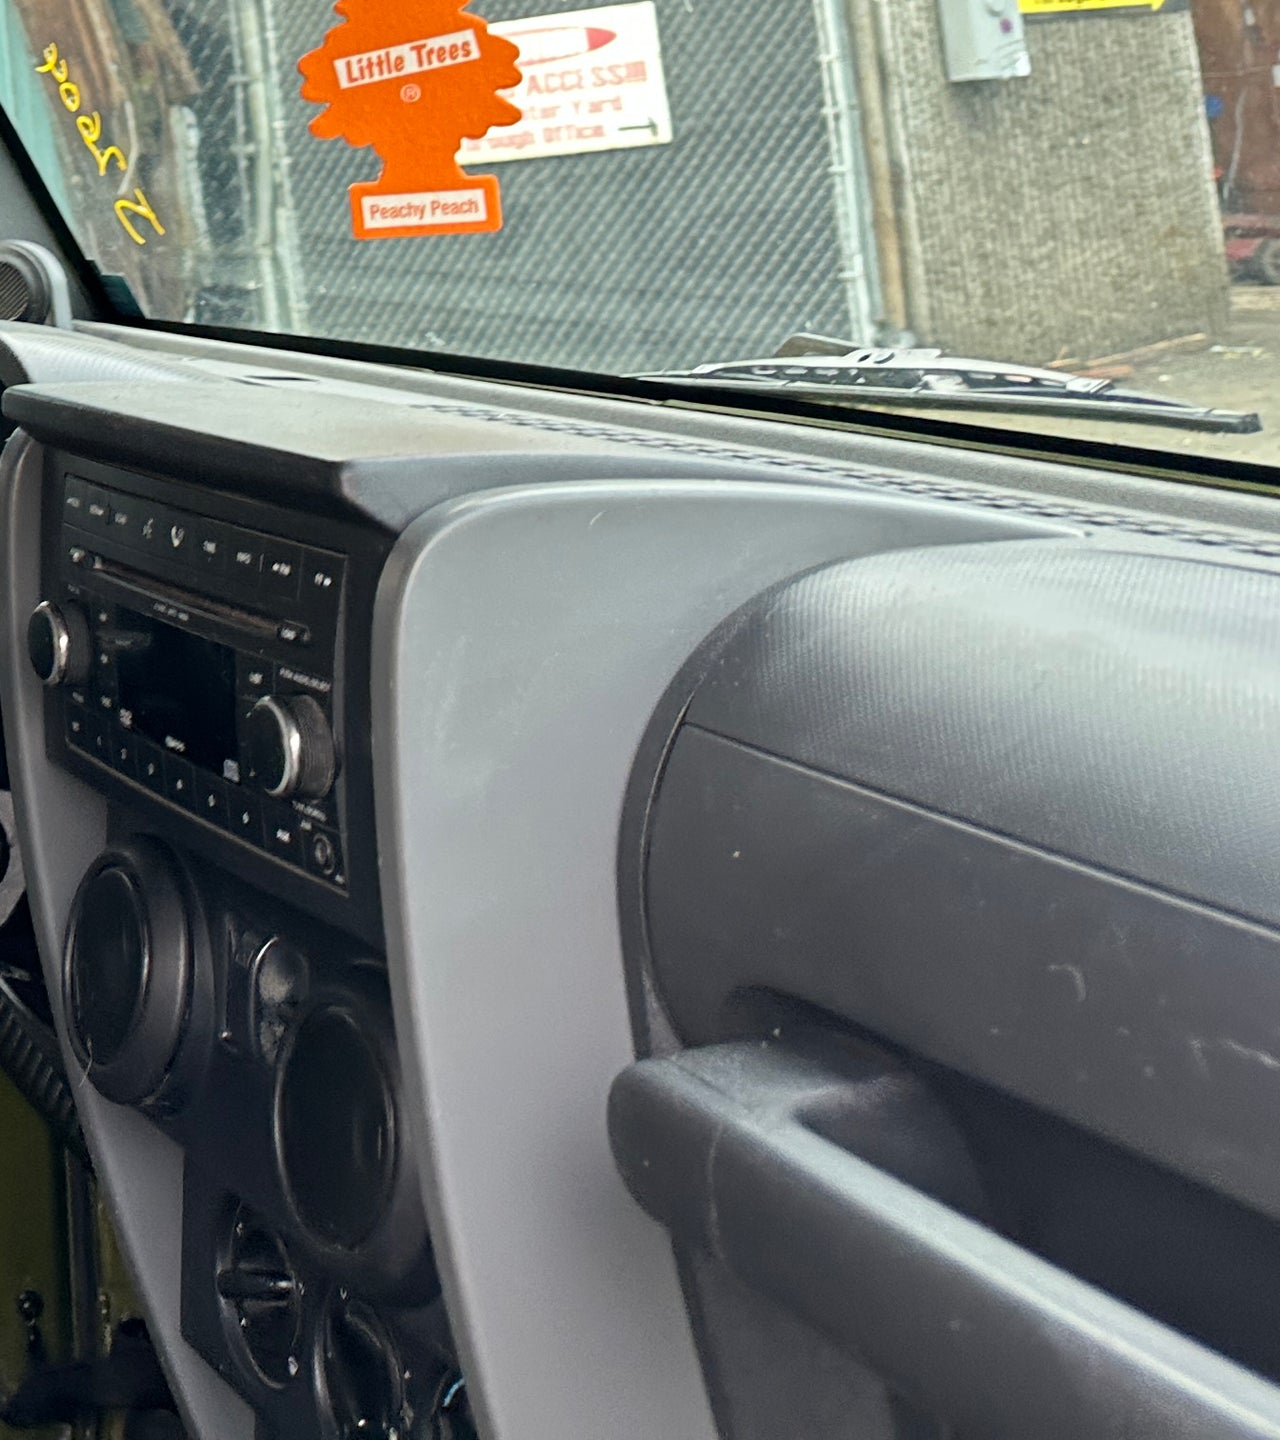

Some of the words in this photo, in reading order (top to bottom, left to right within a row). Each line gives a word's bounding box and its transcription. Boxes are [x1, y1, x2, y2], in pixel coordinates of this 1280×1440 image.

[345, 51, 405, 83] Little
[409, 41, 472, 68] Trees
[369, 202, 426, 220] Peachy
[430, 198, 479, 216] Peach
